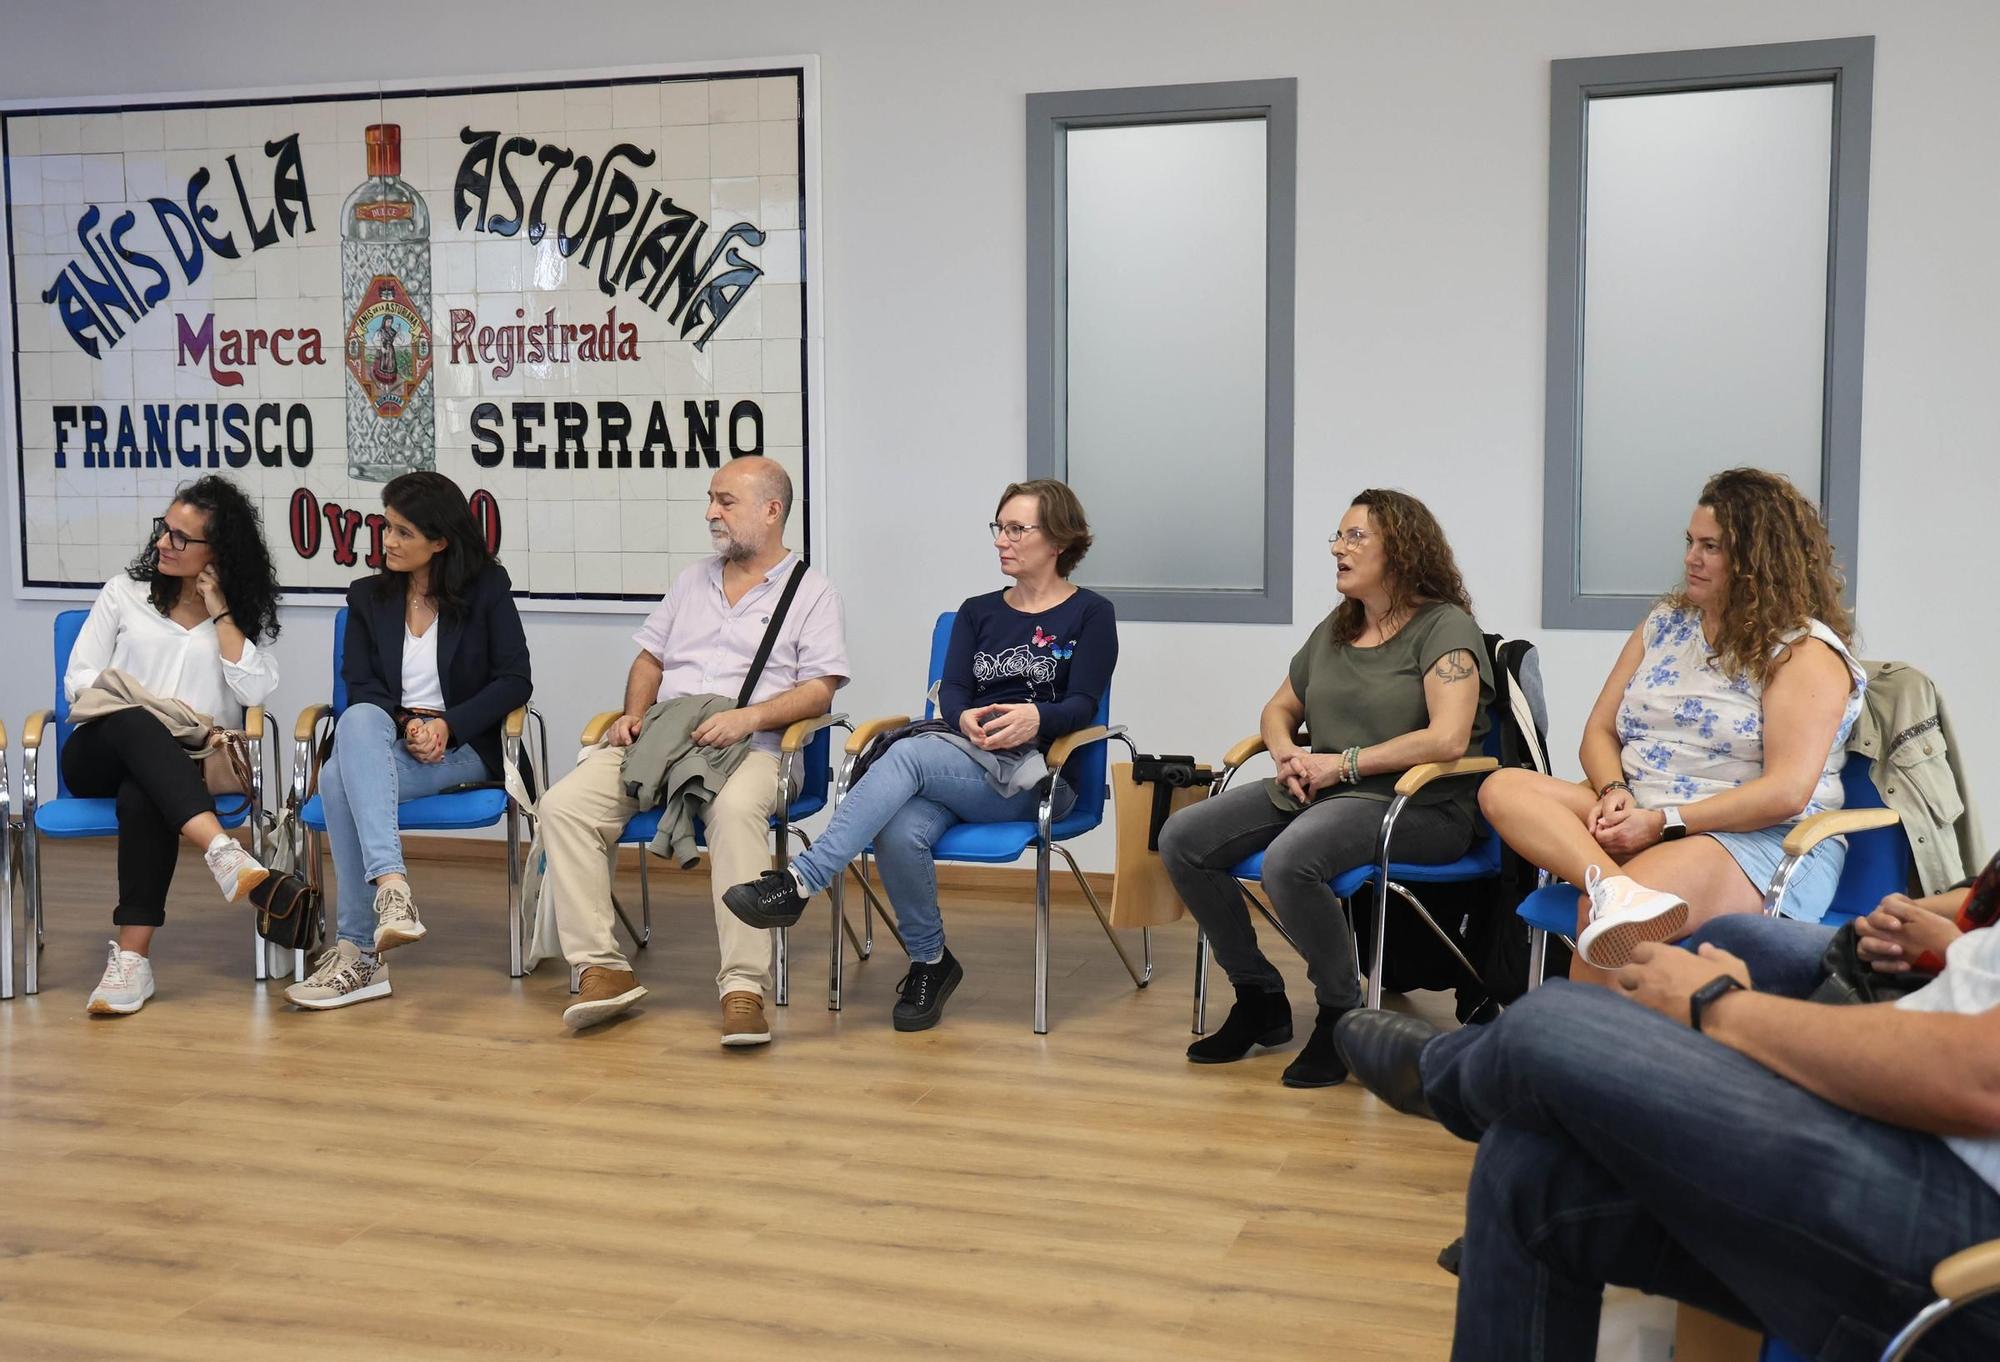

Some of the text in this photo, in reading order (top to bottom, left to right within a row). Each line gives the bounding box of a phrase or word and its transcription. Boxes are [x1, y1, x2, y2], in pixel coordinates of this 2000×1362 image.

[42, 125, 767, 361] ANIS DE LA ASTURIANA
[175, 305, 642, 387] Marca Registrada
[358, 309, 374, 327] ANIS
[384, 303, 418, 327] ASTURIANA
[52, 399, 765, 469] FRANCISCO SERRANO
